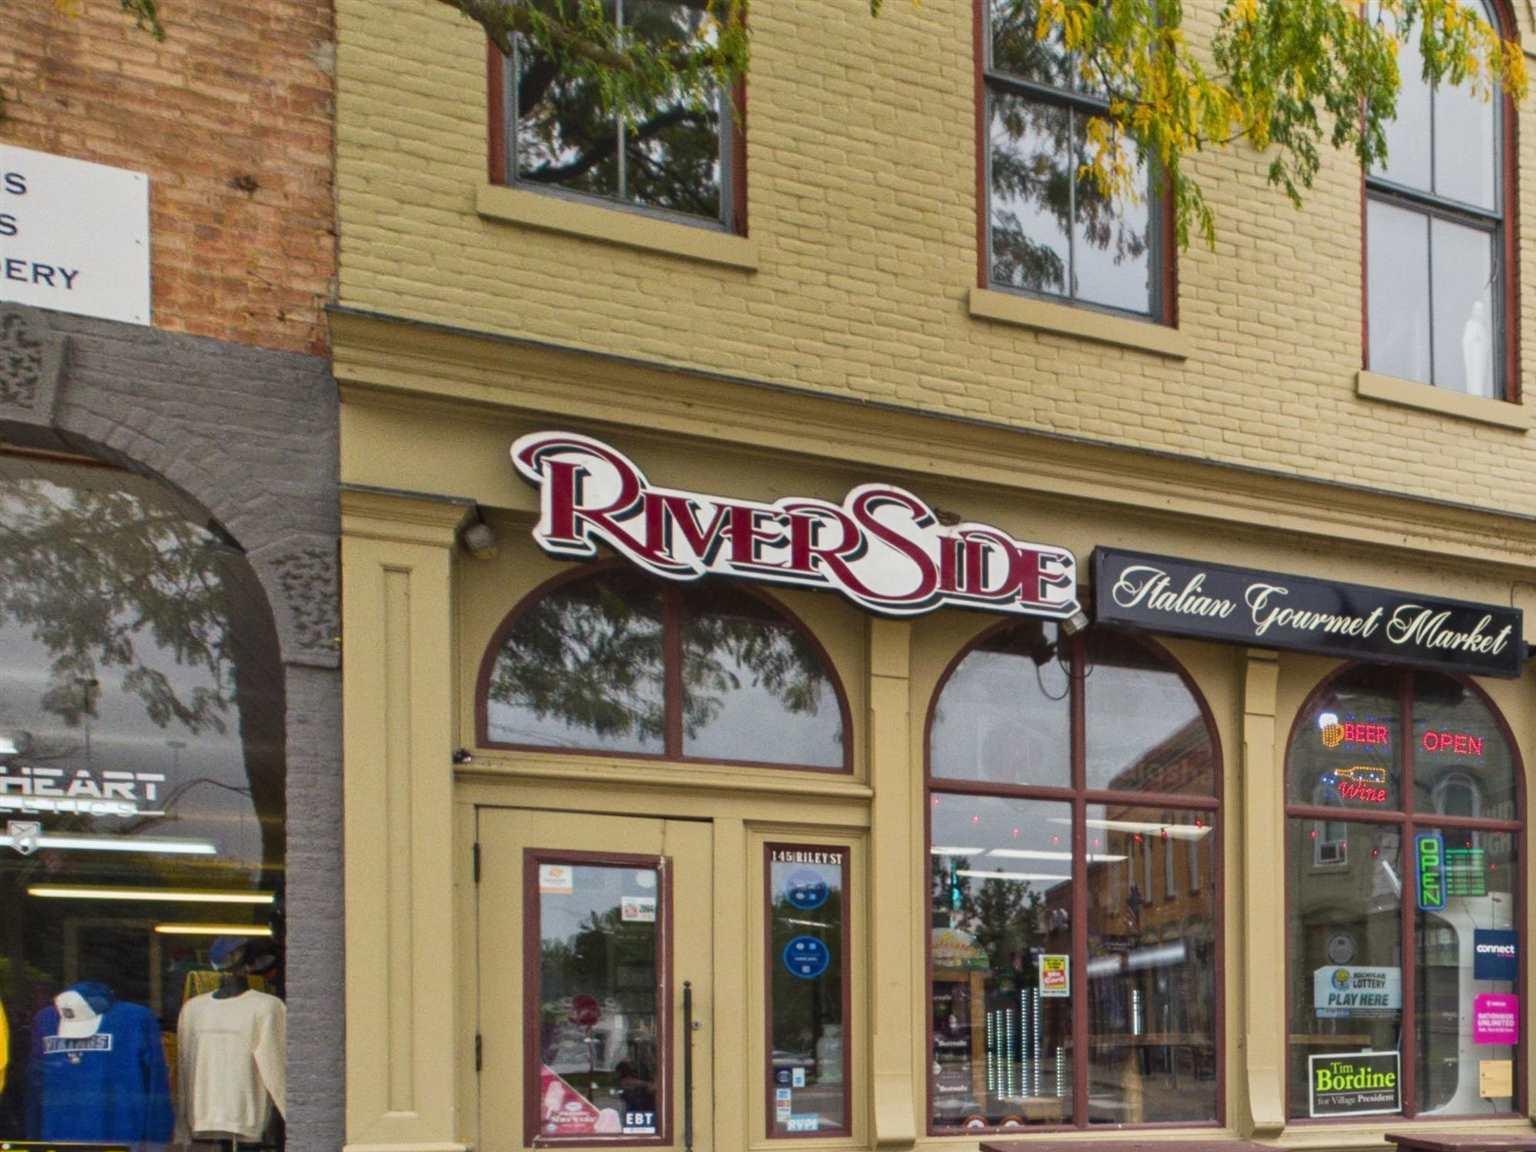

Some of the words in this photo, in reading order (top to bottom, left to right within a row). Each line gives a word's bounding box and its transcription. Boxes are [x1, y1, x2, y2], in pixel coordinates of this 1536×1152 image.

[0, 257, 79, 290] ERY
[1111, 565, 1237, 620] Italian
[1245, 583, 1384, 636] Gourmet
[1386, 603, 1512, 655] Market
[1344, 723, 1388, 744] BEER
[1422, 731, 1485, 755] OPEN
[0, 766, 165, 801] HEART
[1338, 780, 1387, 802] Wine
[1420, 838, 1441, 906] OPEN
[1353, 979, 1386, 989] LOTTERY
[1328, 993, 1358, 1006] PLAY
[1359, 993, 1389, 1007] HERE
[1316, 1067, 1397, 1091] Bordine
[1331, 1062, 1354, 1074] Tim
[625, 1112, 653, 1125] EBT
